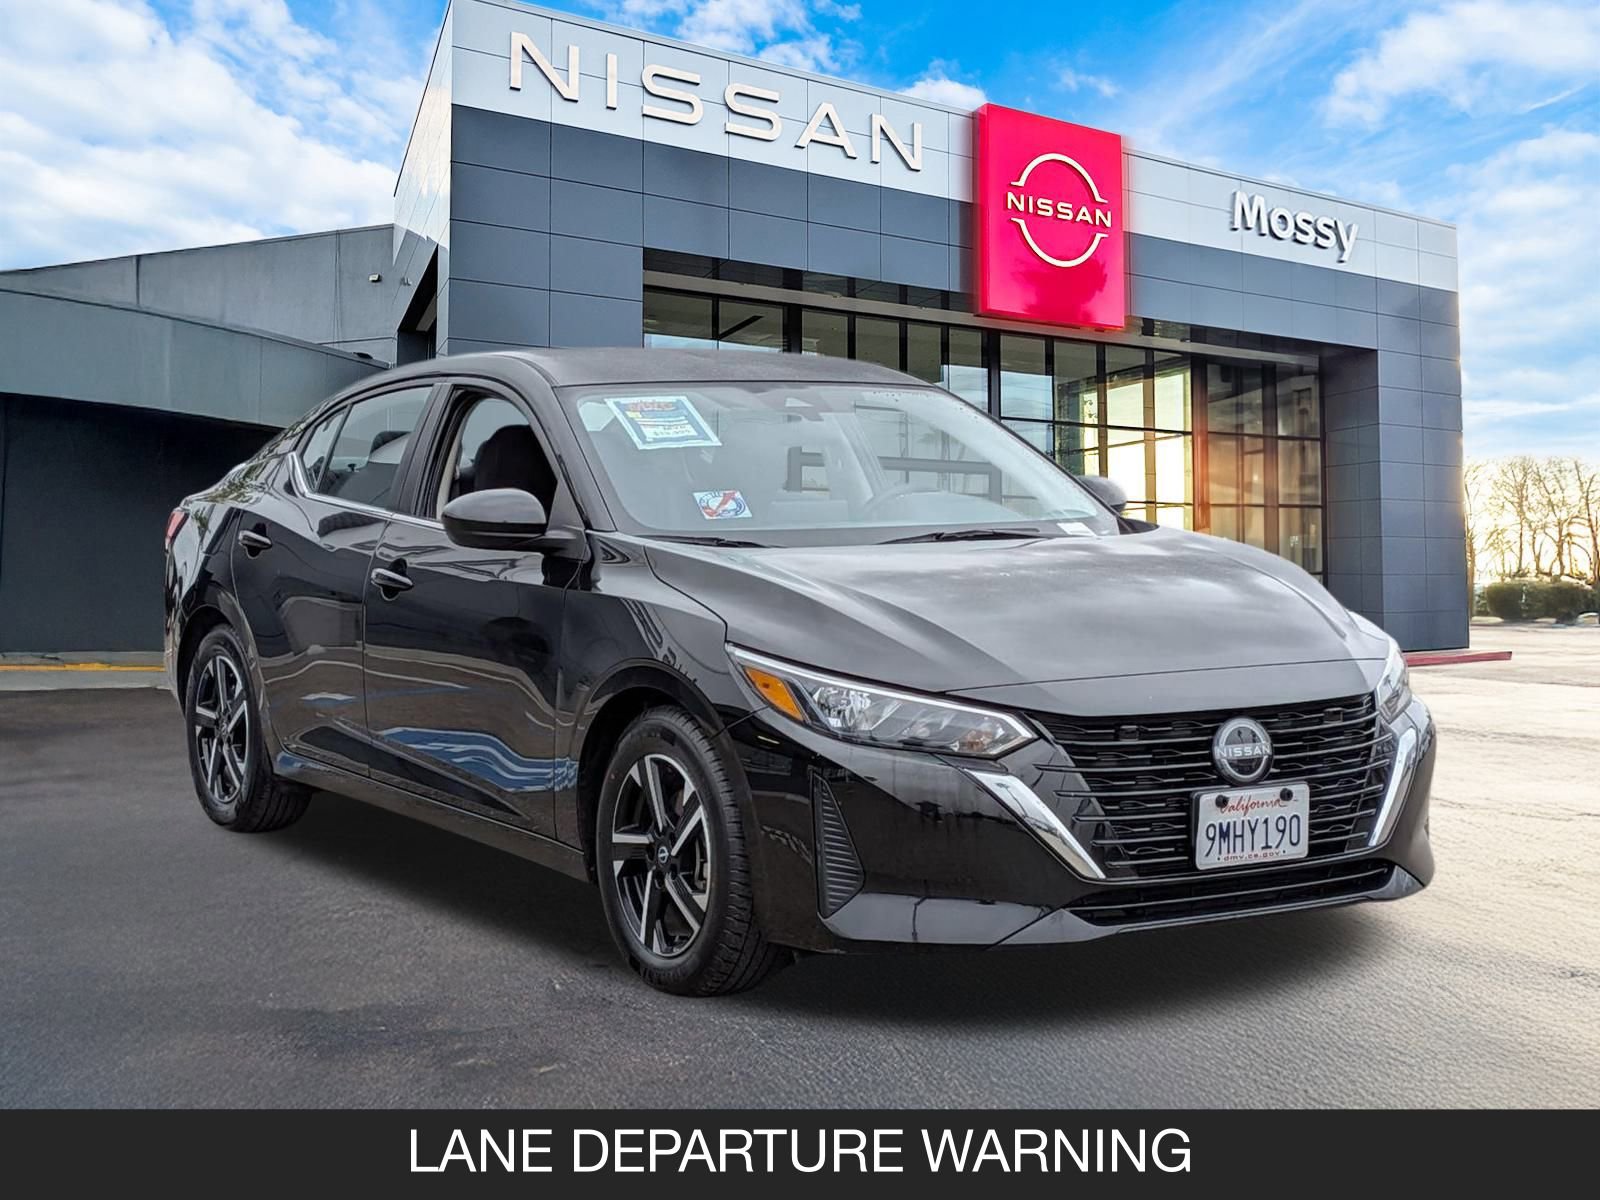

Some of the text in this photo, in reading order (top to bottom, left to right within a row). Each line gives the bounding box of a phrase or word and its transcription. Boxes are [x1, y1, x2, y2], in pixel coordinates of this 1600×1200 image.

[509, 31, 923, 172] NISSAN
[1006, 191, 1112, 229] NISSAN
[1230, 190, 1358, 263] Mossy
[1214, 745, 1271, 758] NISSAN
[1205, 814, 1301, 858] 9MHY190
